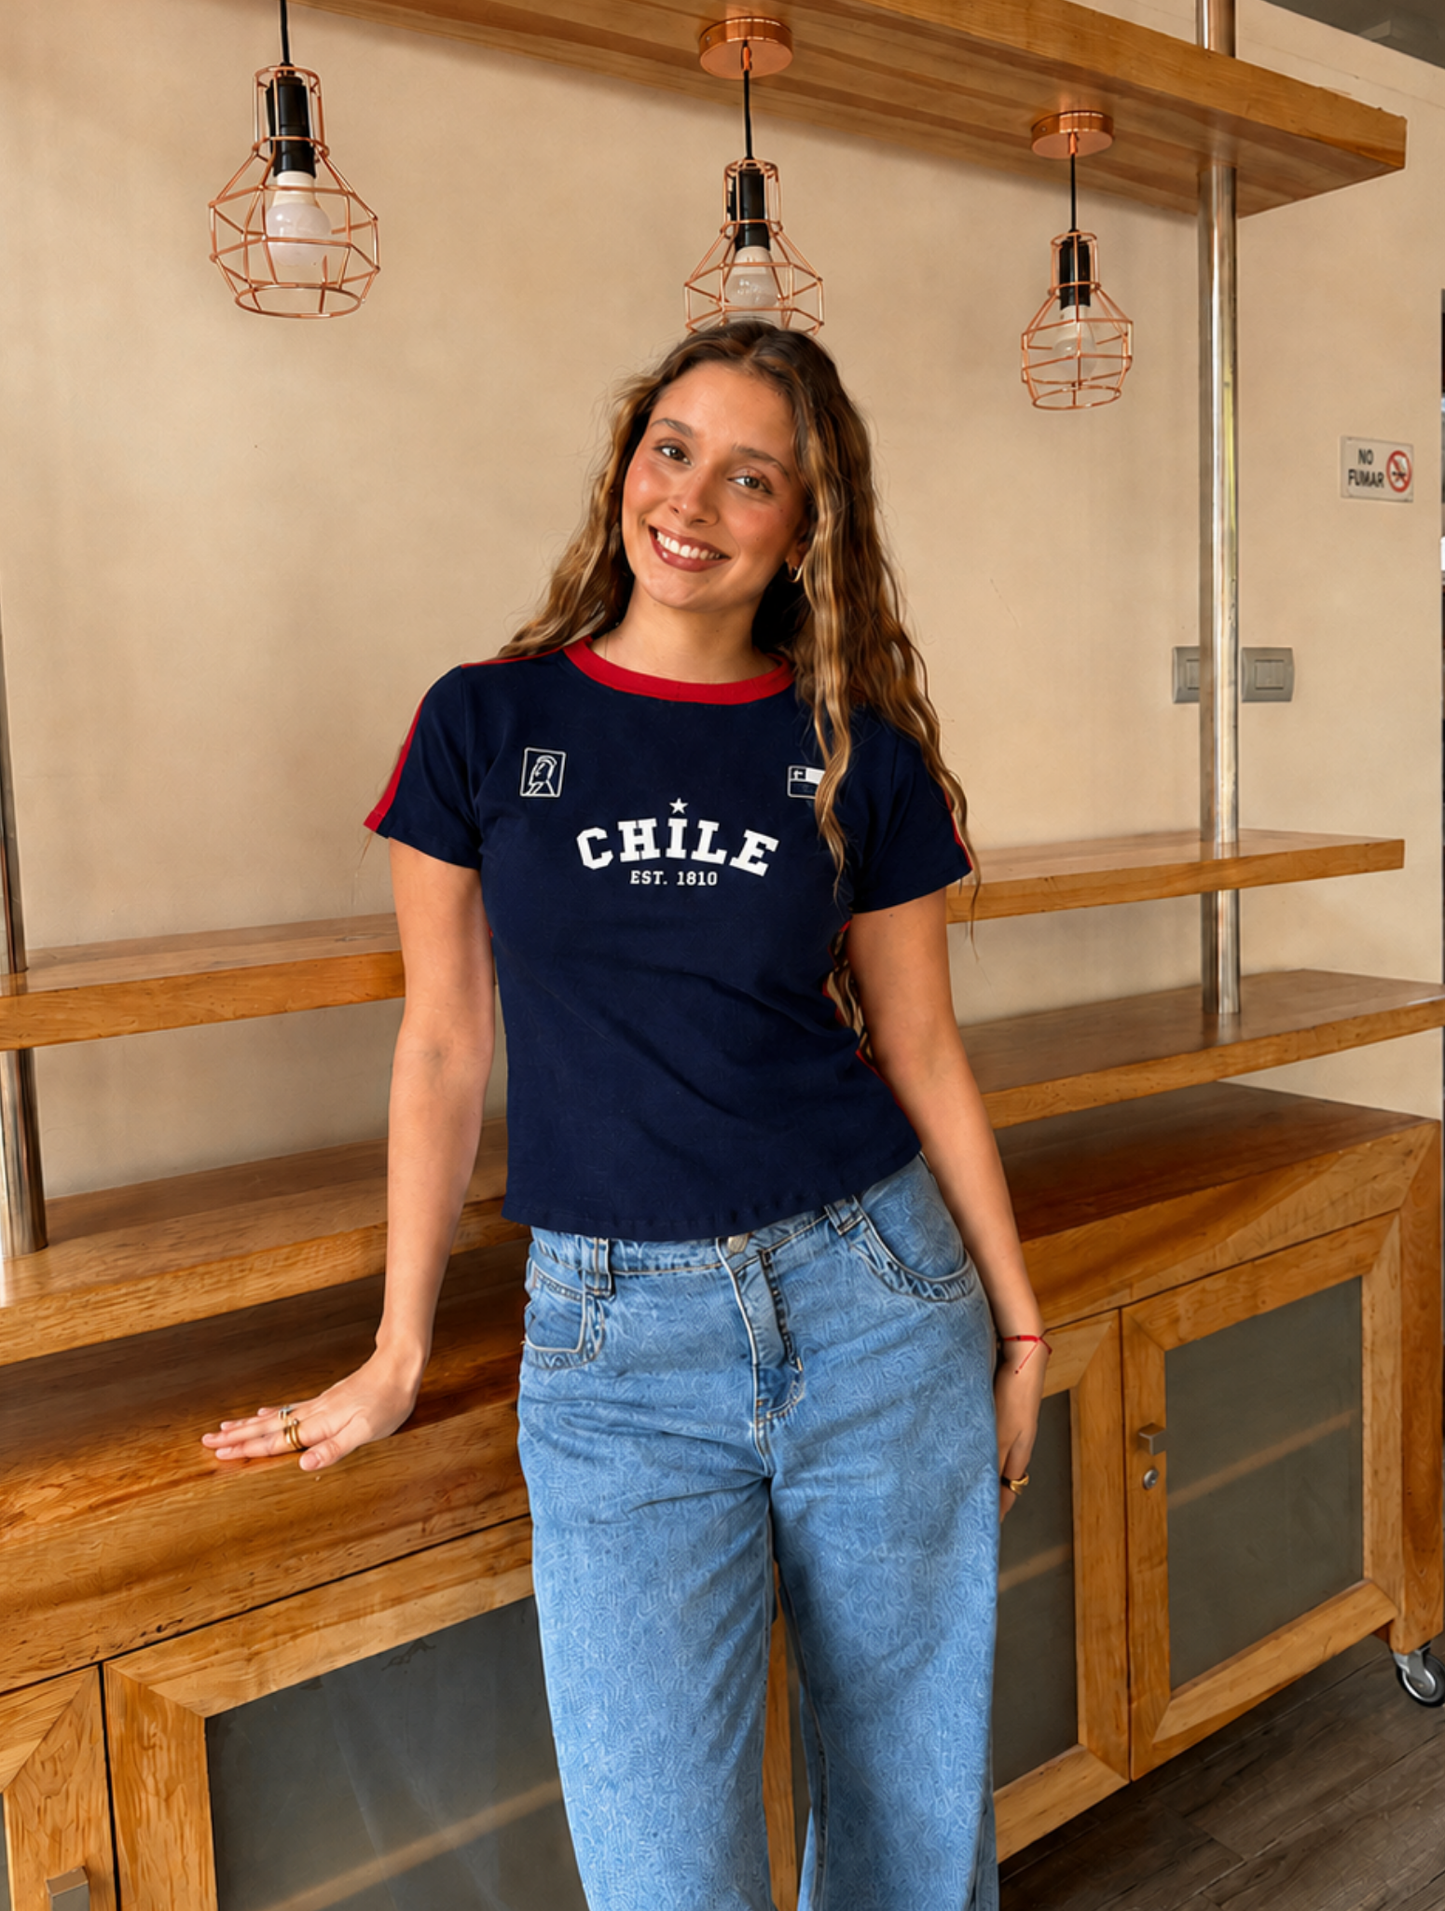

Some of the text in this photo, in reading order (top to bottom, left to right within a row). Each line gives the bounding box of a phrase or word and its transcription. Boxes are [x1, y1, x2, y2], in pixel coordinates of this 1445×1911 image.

[1358, 448, 1374, 465] NO
[1348, 468, 1385, 488] FUMAR
[576, 817, 779, 877] CHILE
[630, 870, 718, 886] EST. 1810
